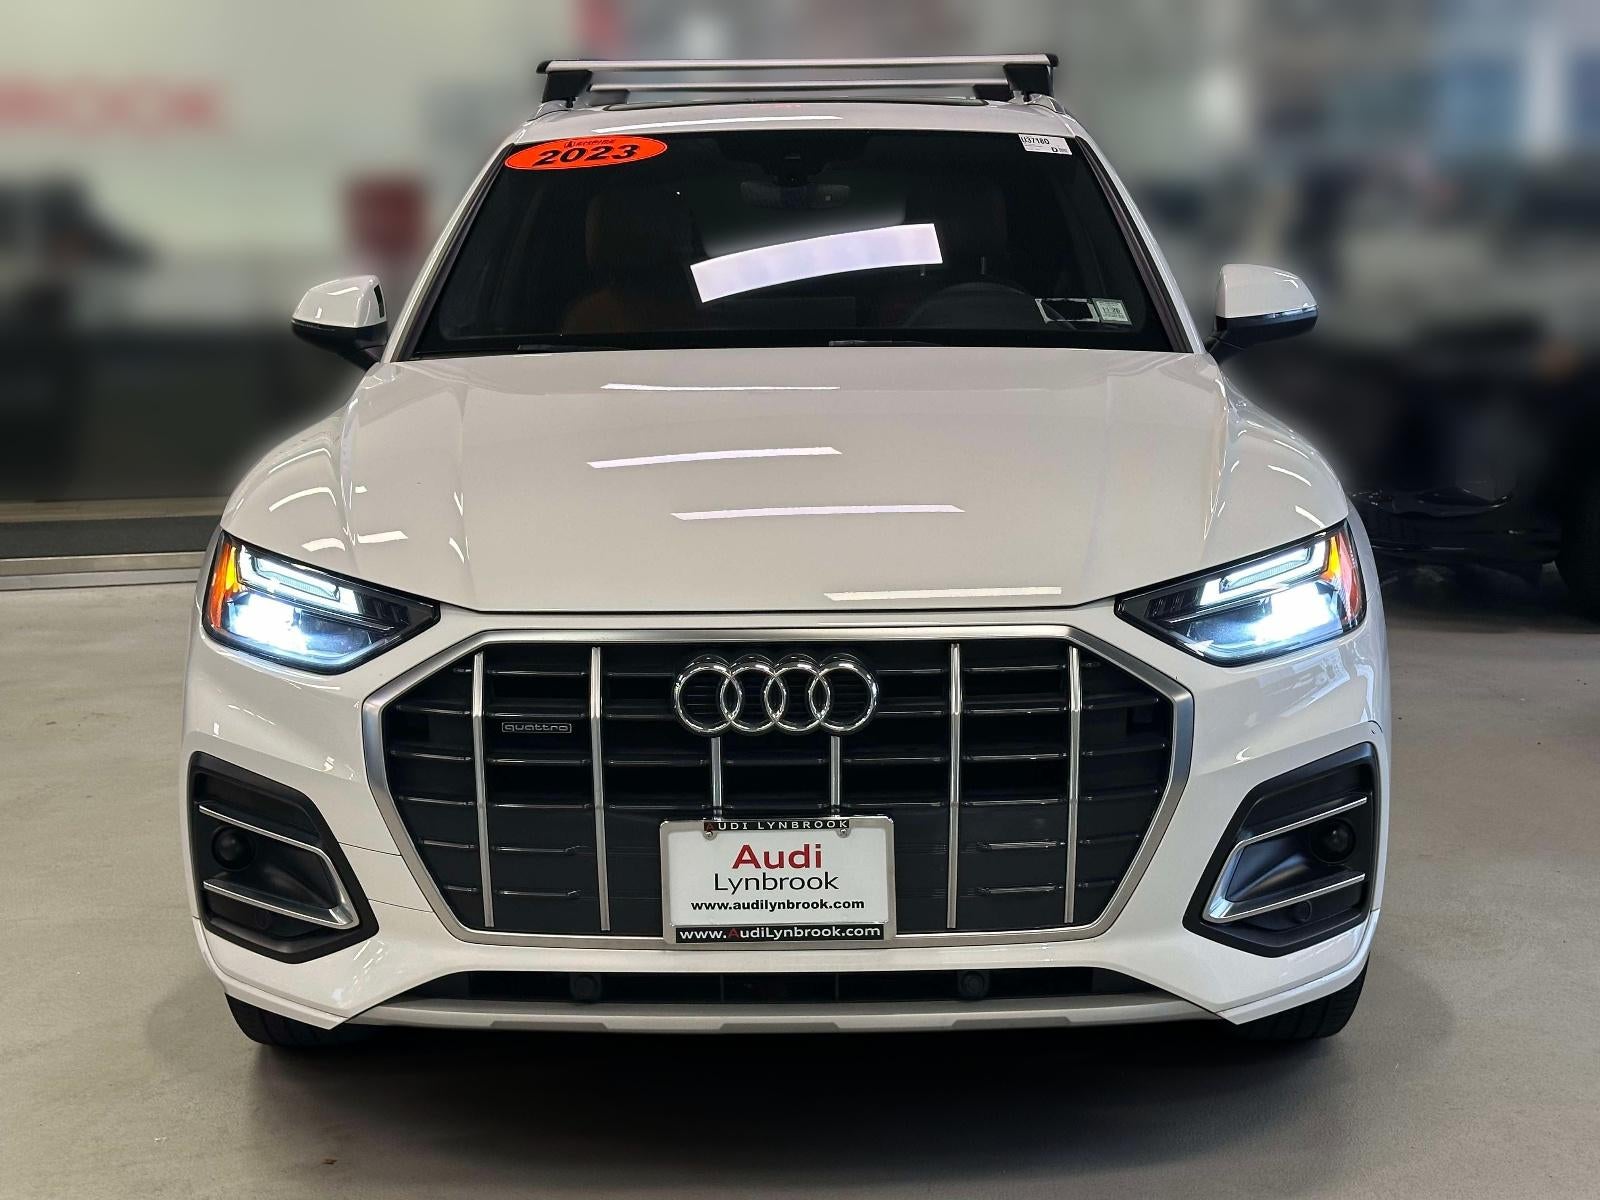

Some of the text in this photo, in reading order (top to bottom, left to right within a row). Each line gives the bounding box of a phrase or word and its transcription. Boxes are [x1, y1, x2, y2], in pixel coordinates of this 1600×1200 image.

[532, 144, 640, 166] 2023
[504, 724, 569, 732] quattro
[706, 820, 848, 831] AUDI LYNBROOK
[732, 843, 823, 870] Audi
[714, 872, 839, 895] Lynbrook
[691, 899, 865, 912] www.audilynbrook.com
[680, 926, 881, 943] www.AudiLynbrook.com
